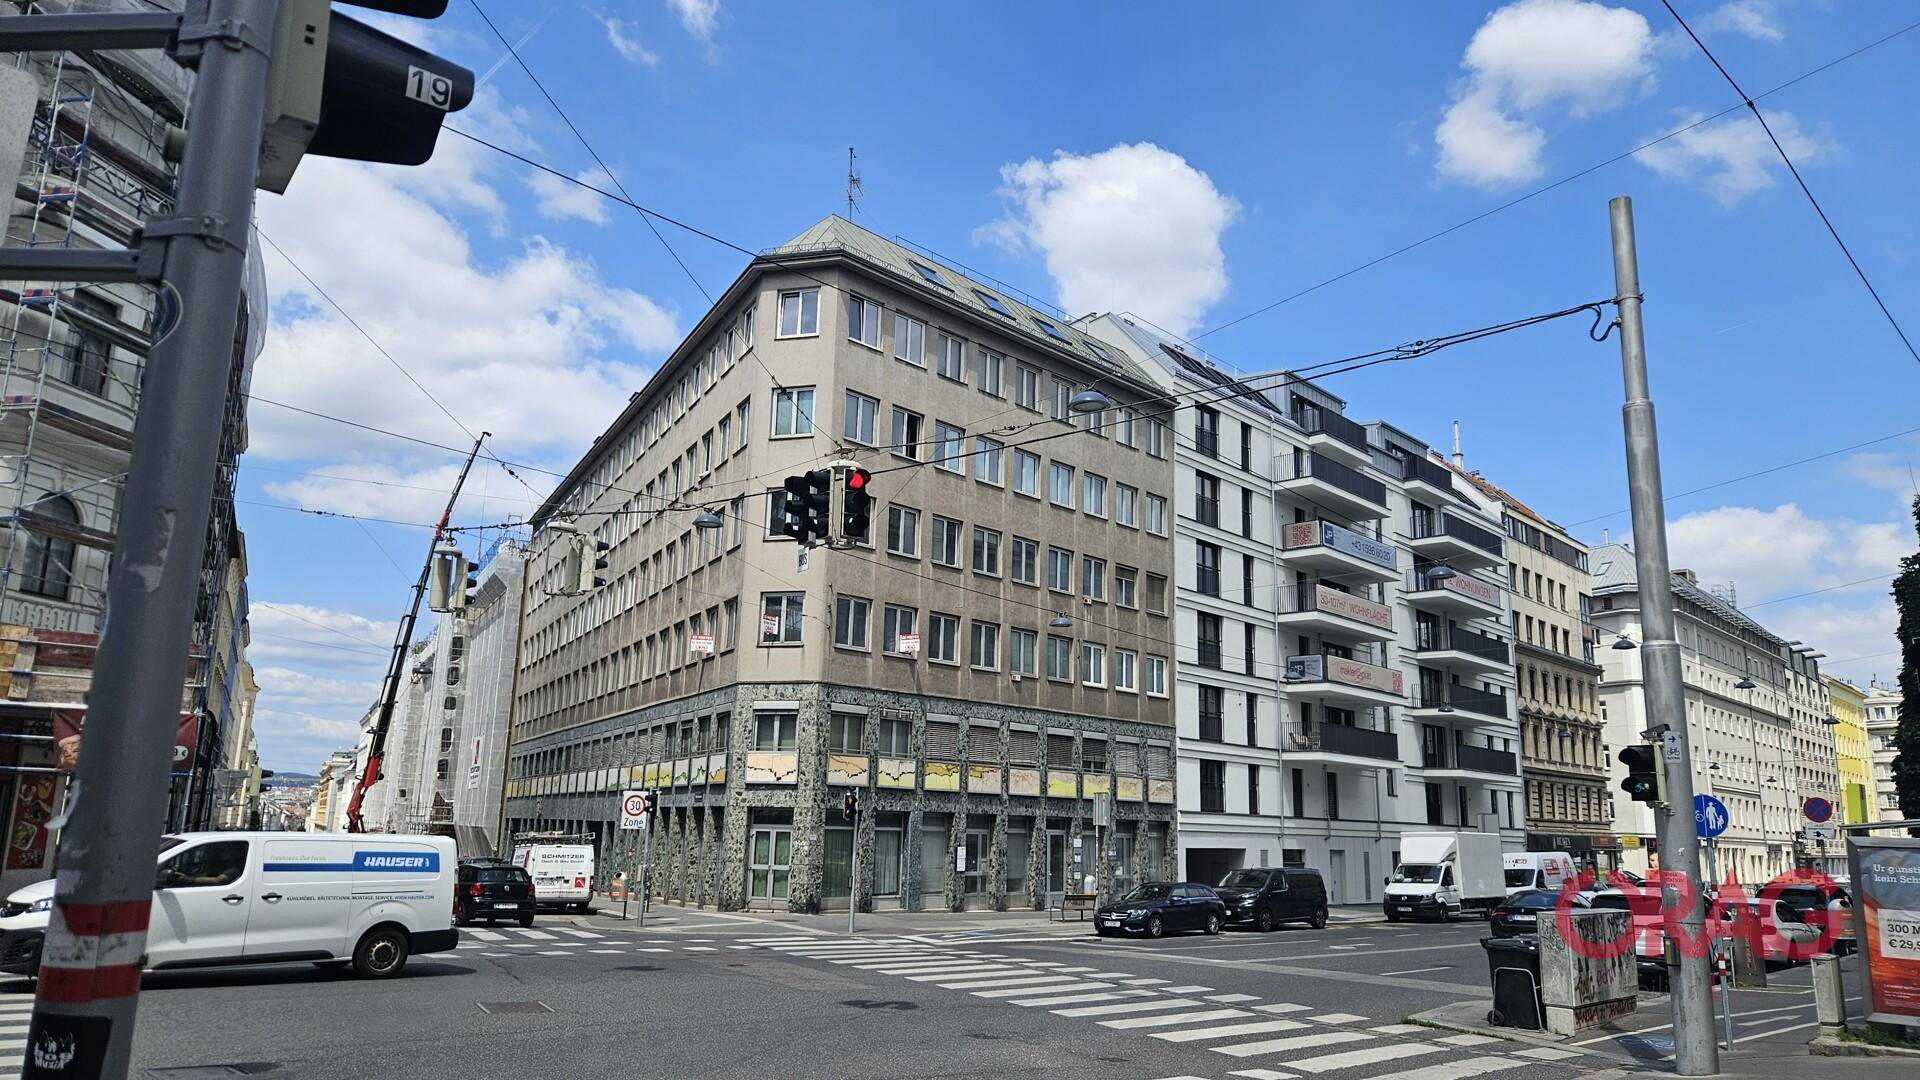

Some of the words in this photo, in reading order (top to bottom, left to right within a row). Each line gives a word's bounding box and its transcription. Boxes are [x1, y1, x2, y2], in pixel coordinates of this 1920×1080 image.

[412, 70, 450, 106] 19
[630, 800, 641, 811] 30
[623, 817, 644, 827] Zone
[364, 856, 423, 867] HAUSER
[1873, 863, 1885, 872] Ur
[1874, 874, 1897, 883] kein
[1900, 875, 1920, 884] Sch
[1888, 923, 1909, 934] 300
[1889, 938, 1898, 948] €
